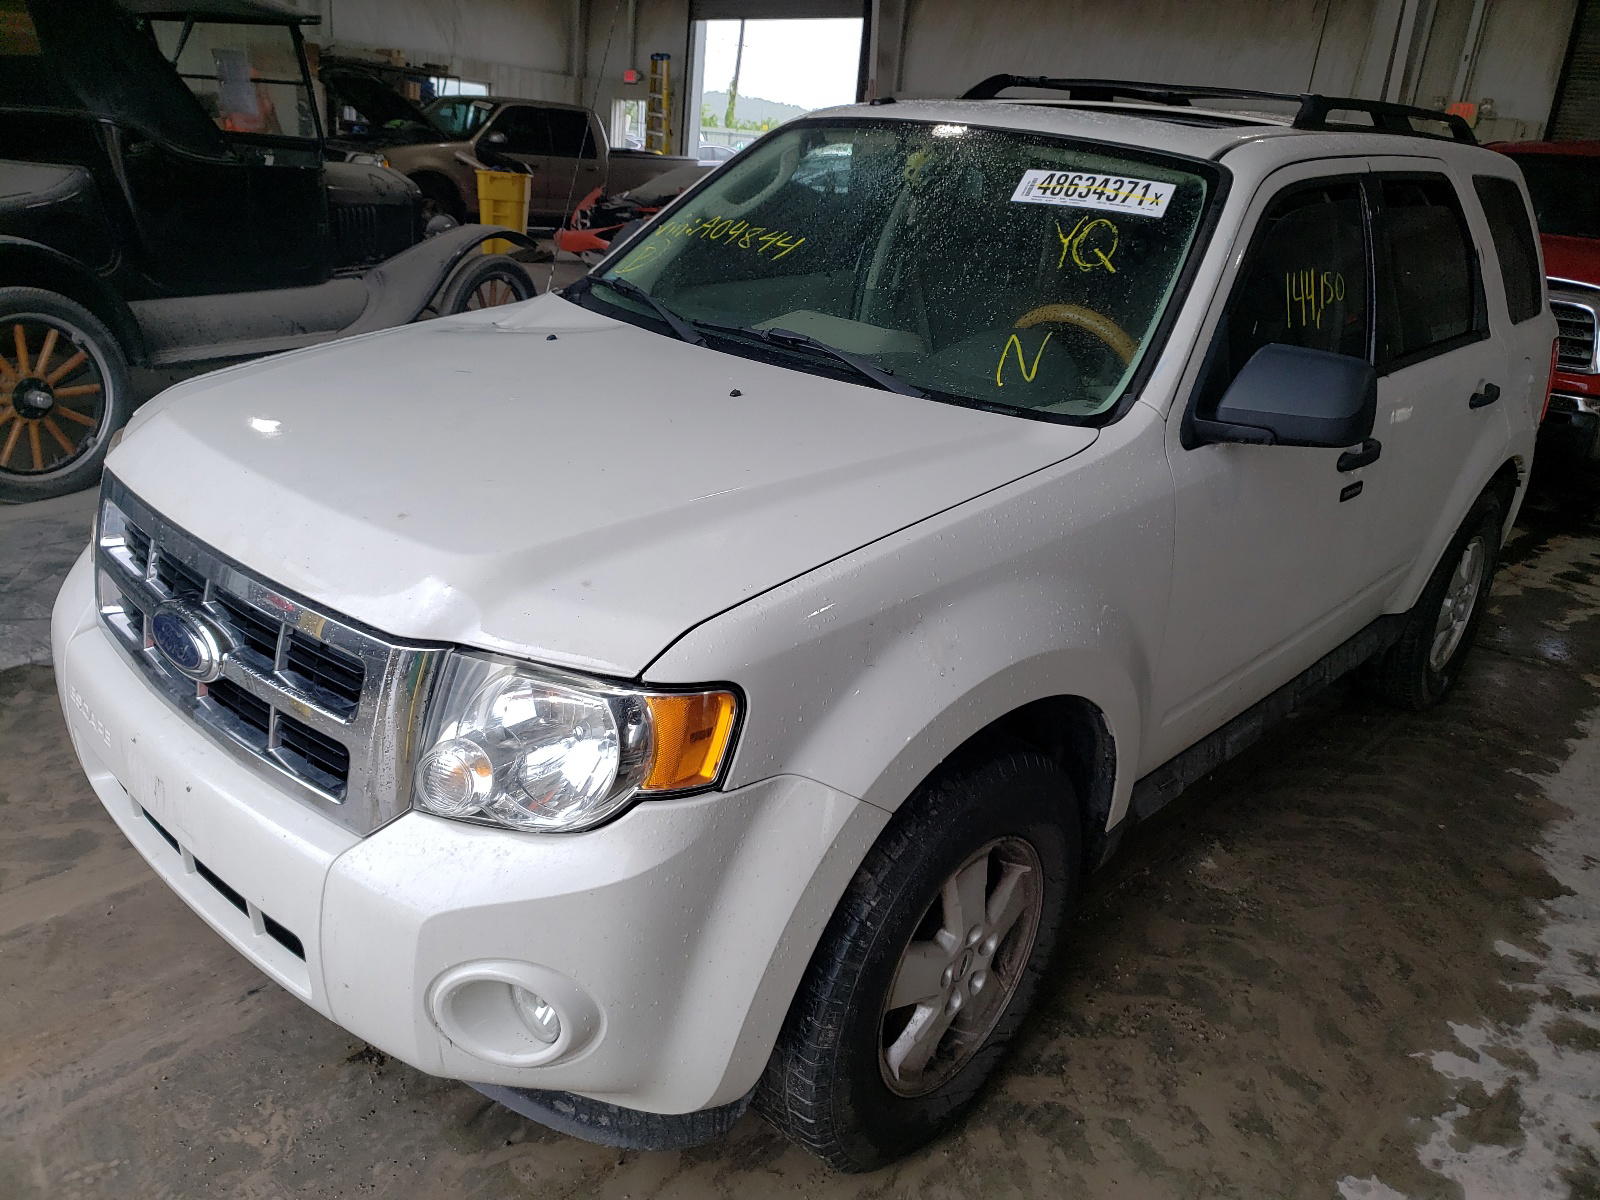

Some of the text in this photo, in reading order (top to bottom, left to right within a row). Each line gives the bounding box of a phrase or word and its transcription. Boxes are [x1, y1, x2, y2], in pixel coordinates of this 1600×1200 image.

[1036, 172, 1152, 207] 48634371
[1055, 215, 1119, 274] YQ
[996, 331, 1053, 387] N
